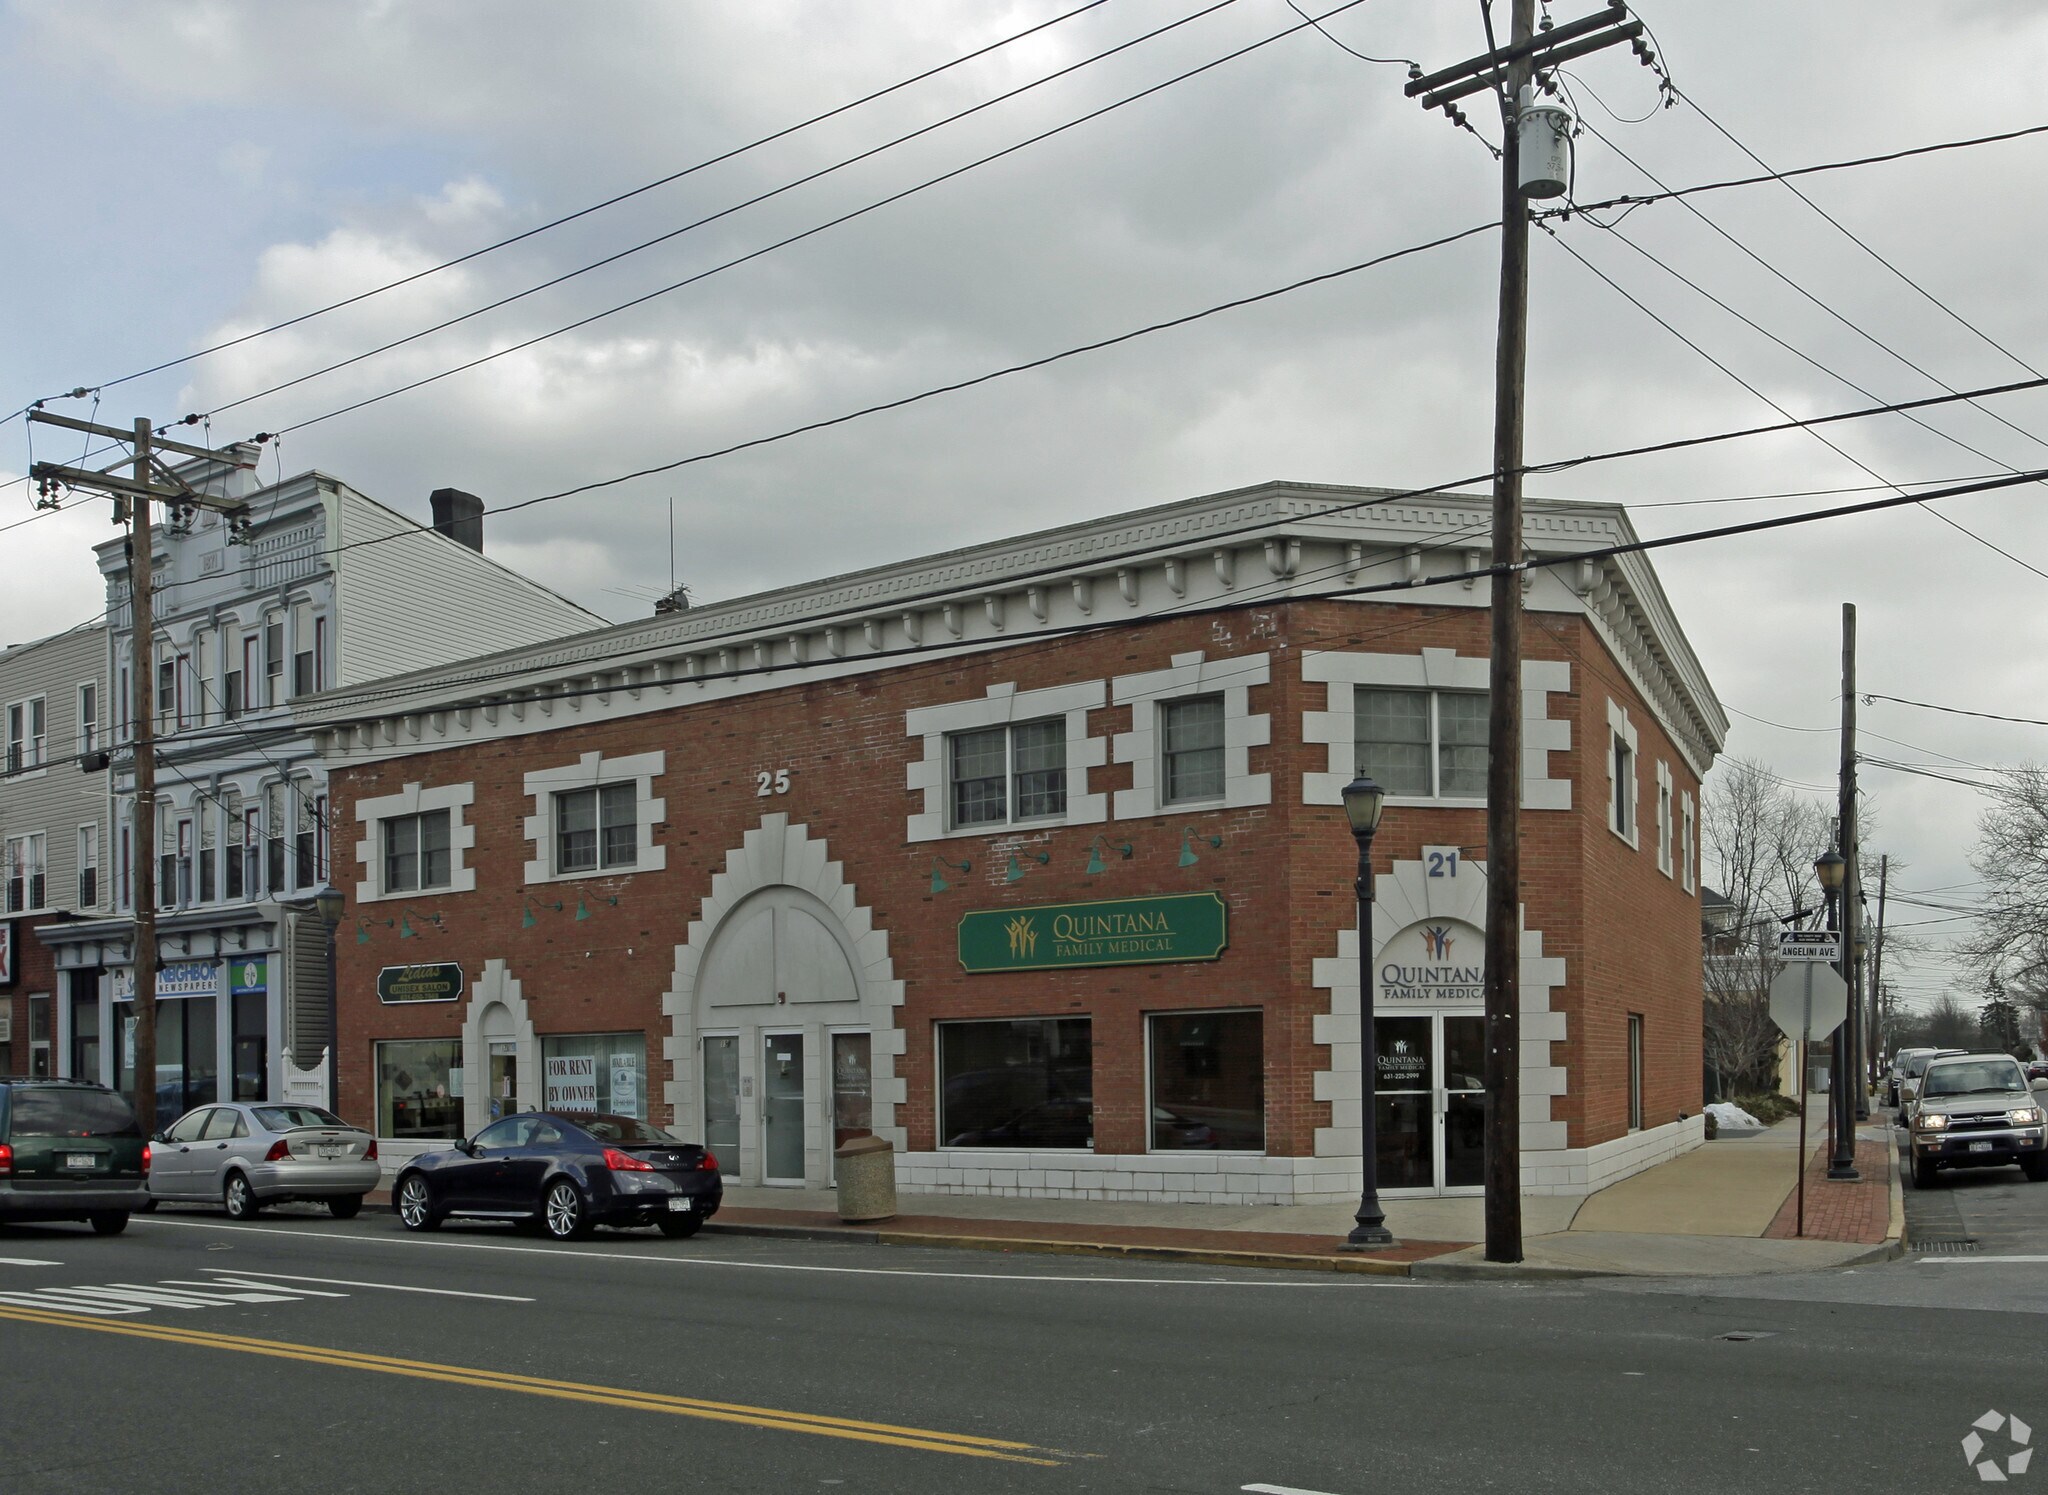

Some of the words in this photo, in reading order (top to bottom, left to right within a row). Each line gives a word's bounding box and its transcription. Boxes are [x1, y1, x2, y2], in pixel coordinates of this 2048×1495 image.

[757, 769, 790, 796] 25
[1428, 852, 1456, 877] 21
[1053, 911, 1169, 942] QUINTANA
[1056, 943, 1102, 957] FAMILY
[1108, 939, 1173, 954] MEDICAL
[1782, 947, 1817, 956] ANGELINI
[159, 962, 216, 983] NEIGHBOR
[159, 981, 217, 993] NEWSPAPERS
[392, 984, 420, 993] UNISEX
[422, 983, 448, 992] SALON
[1384, 989, 1431, 999] FAMILY
[549, 1060, 567, 1075] FOR
[569, 1059, 592, 1075] RENT
[1377, 1055, 1424, 1065] QUINTANA
[549, 1087, 560, 1101] BY
[562, 1086, 595, 1101] OWNER
